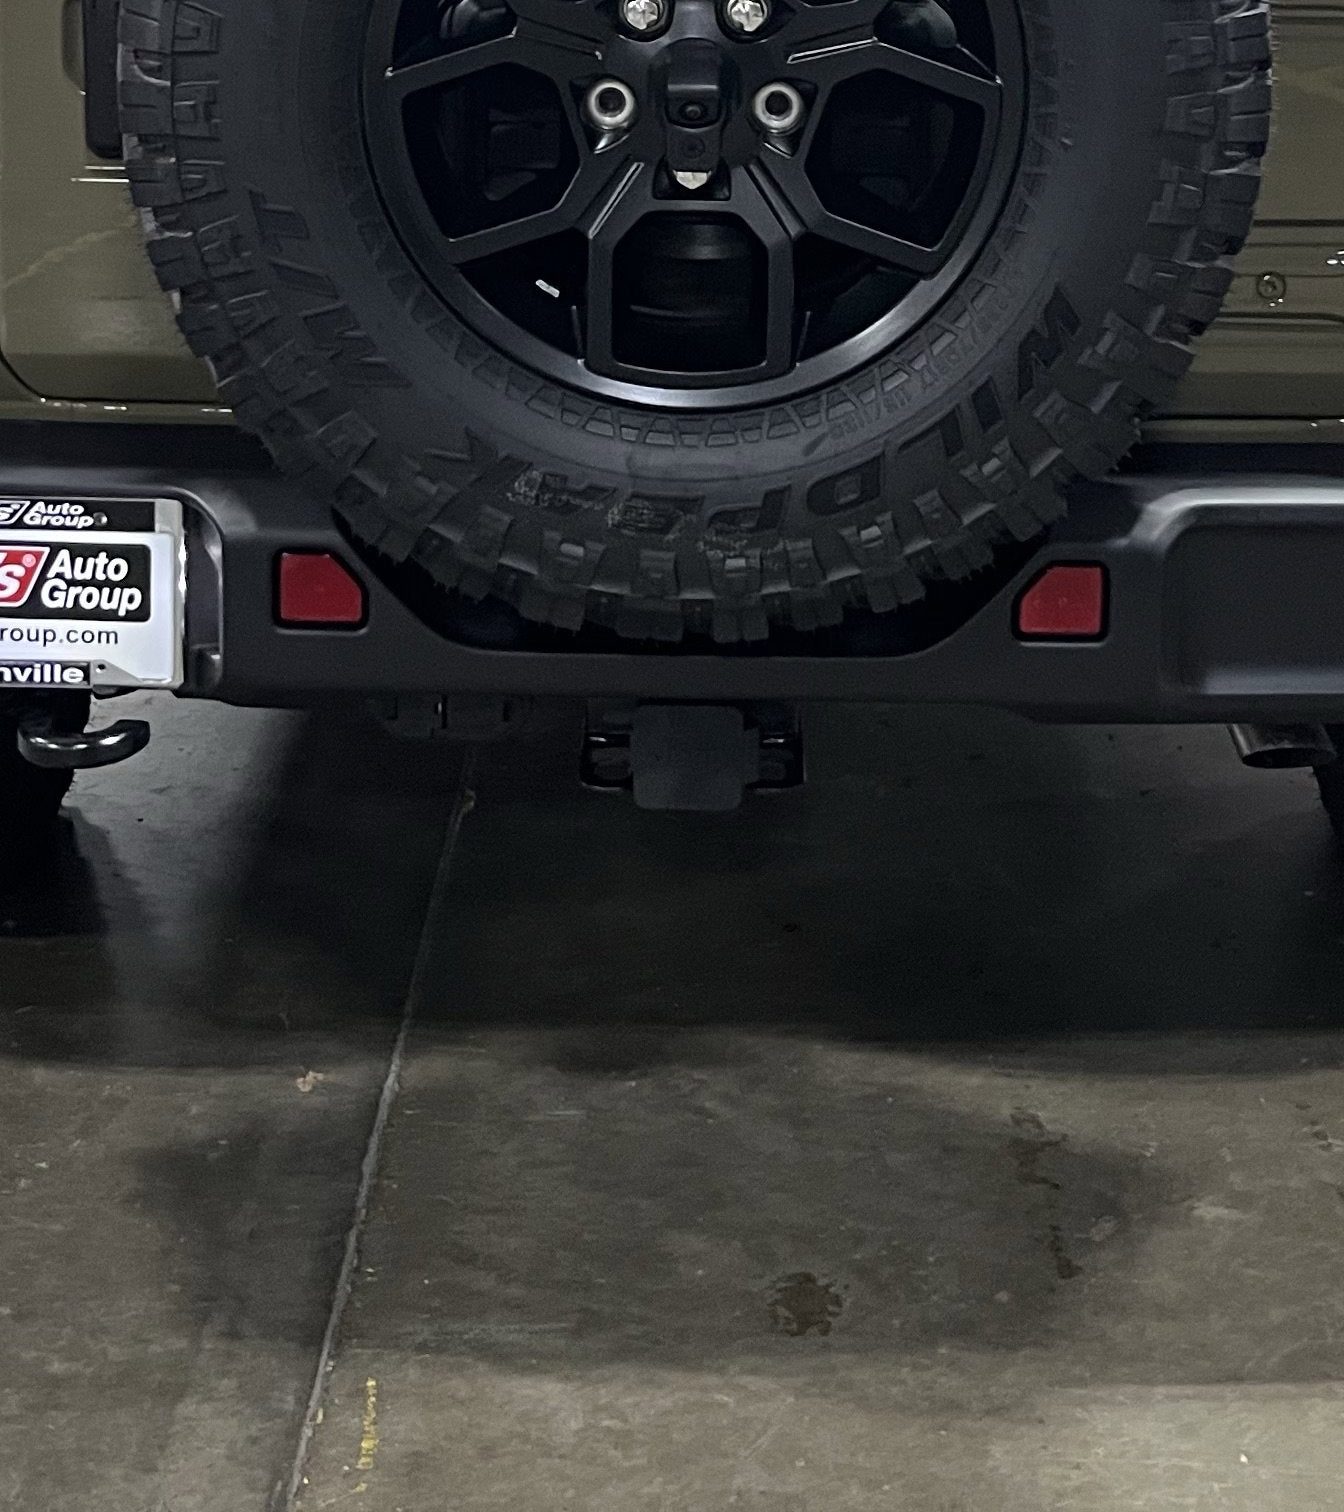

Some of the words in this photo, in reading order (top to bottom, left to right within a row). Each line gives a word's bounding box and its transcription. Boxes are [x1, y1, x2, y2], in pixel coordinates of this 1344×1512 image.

[32, 501, 84, 516] Auto
[23, 513, 94, 529] Group
[46, 549, 129, 582] Auto
[40, 582, 142, 616] Group
